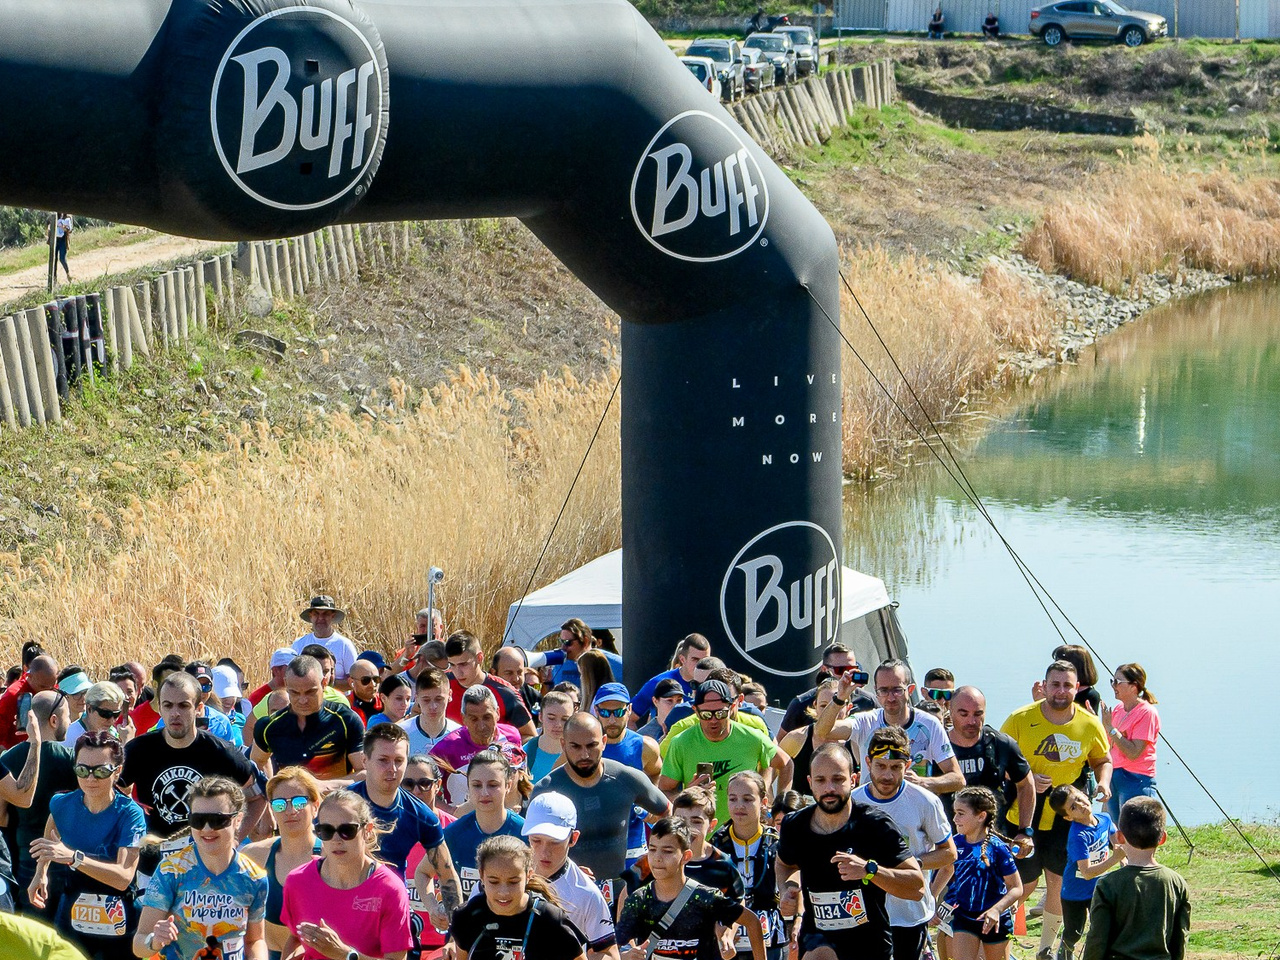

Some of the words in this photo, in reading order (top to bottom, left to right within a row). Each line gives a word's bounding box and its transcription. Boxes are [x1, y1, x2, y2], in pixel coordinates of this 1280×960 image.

[732, 373, 836, 388] LIVE
[732, 412, 836, 427] MORE
[762, 451, 823, 465] NOW
[160, 768, 201, 786] ШКОЛА
[185, 890, 233, 906] Имаме
[74, 906, 101, 923] 1216
[192, 904, 244, 922] проблем
[813, 905, 841, 919] 0134
